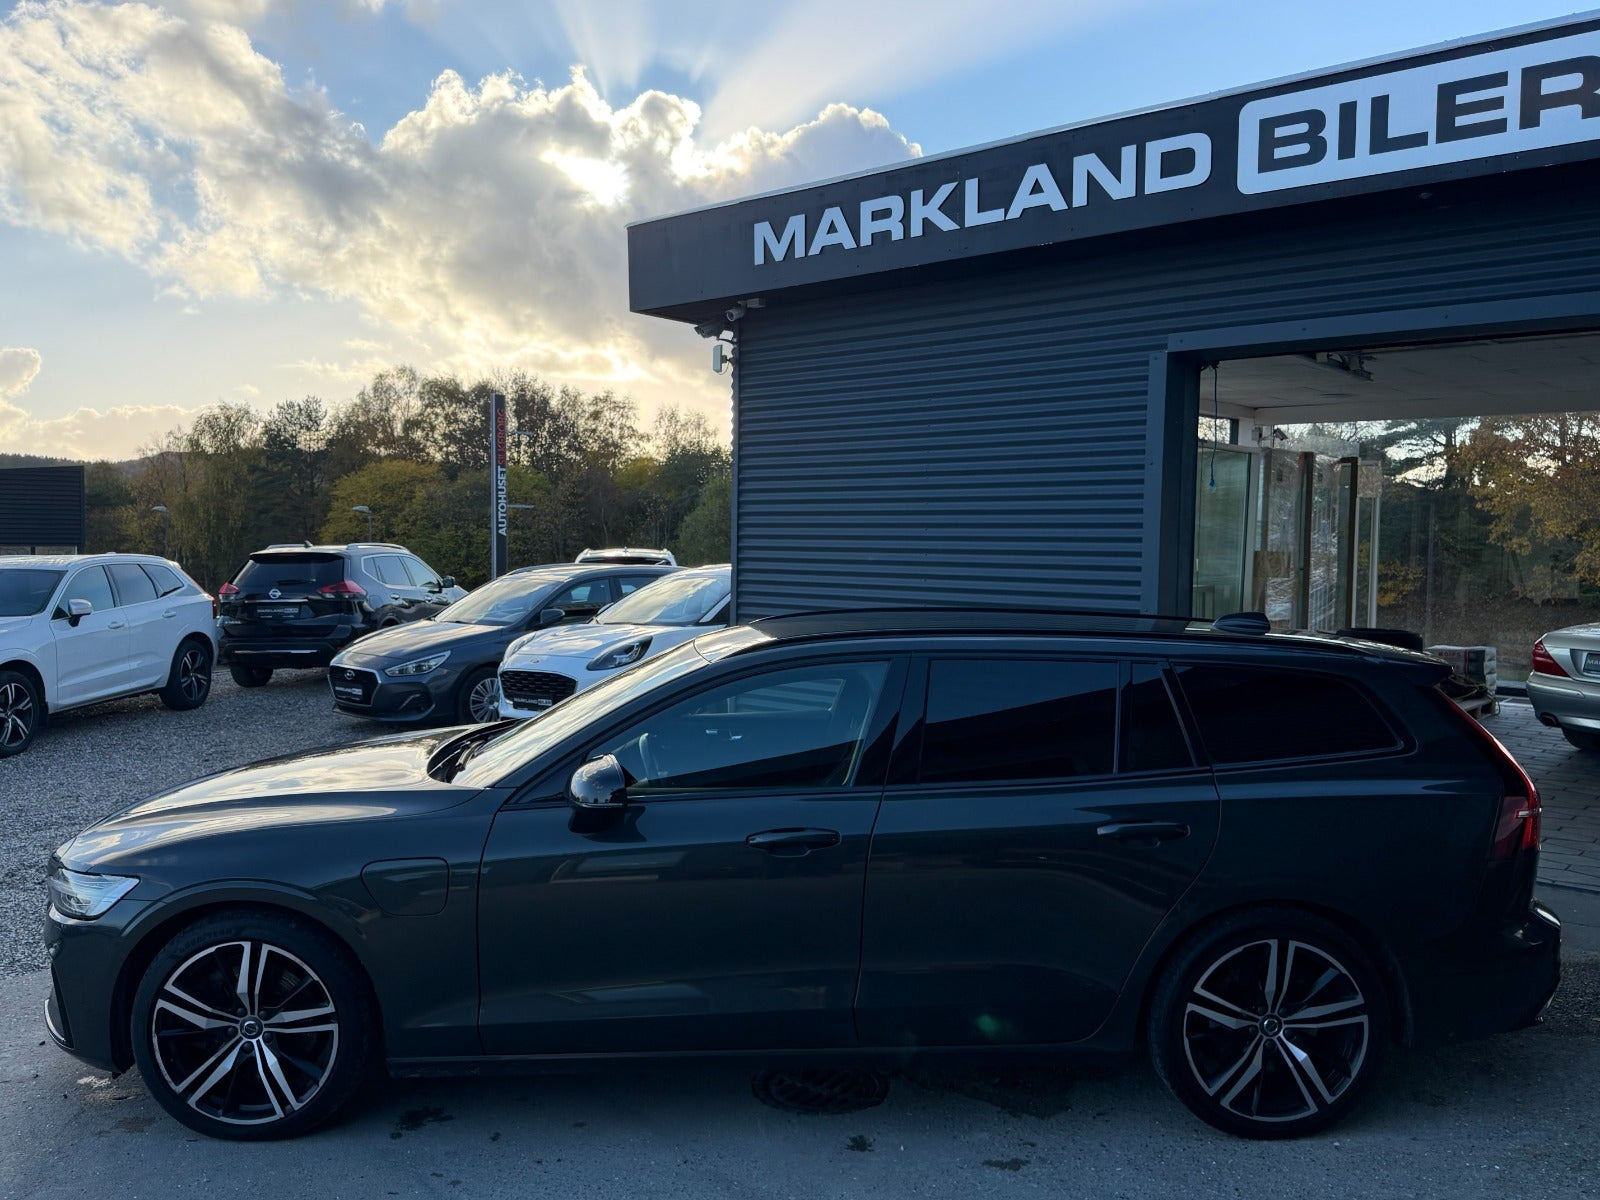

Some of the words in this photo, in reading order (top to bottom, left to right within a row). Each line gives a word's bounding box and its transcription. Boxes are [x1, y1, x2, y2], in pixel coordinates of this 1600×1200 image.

[754, 132, 1212, 265] MARKLAND
[1257, 55, 1600, 174] BILER
[497, 408, 506, 464] SILKEBORG
[498, 465, 507, 536] AUTOHUSET
